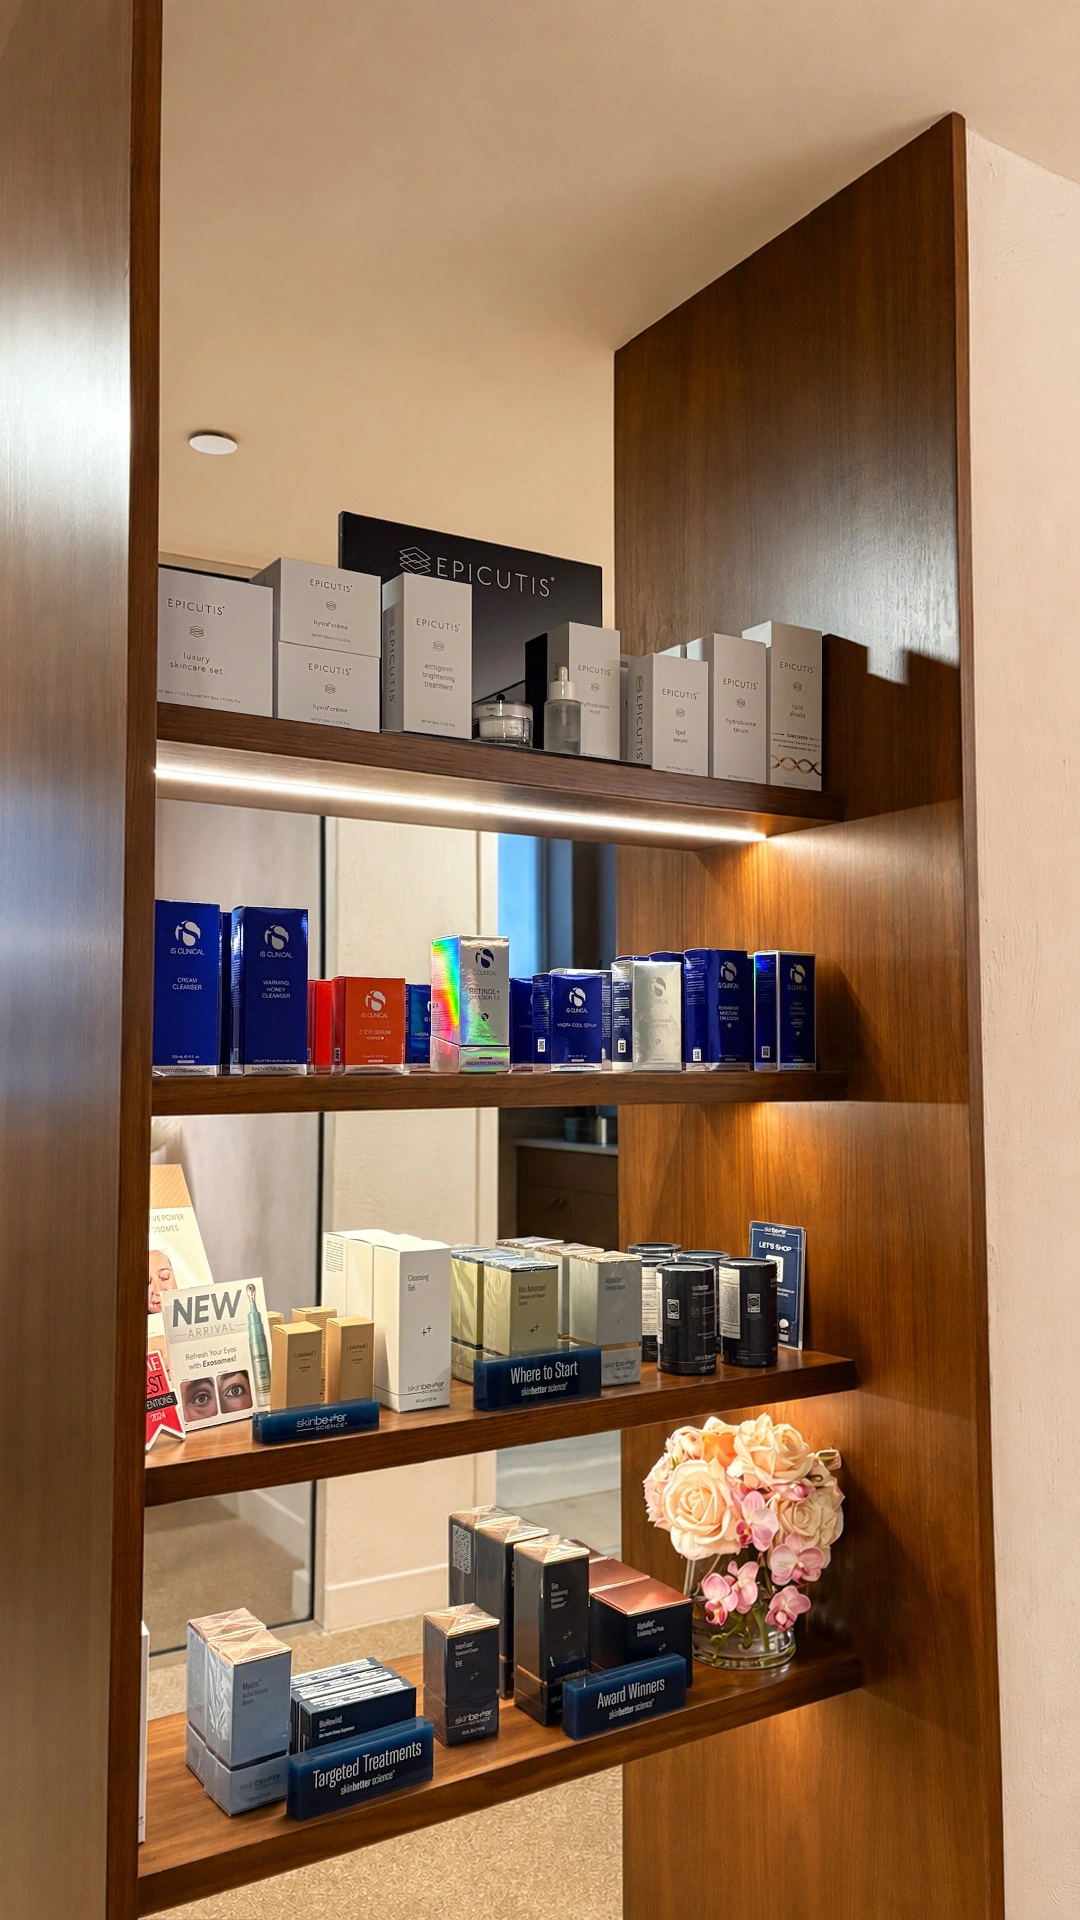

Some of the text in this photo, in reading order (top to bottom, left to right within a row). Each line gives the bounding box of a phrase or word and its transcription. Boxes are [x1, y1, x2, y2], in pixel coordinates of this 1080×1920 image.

[183, 652, 210, 664] luxury
[170, 661, 223, 675] skincare set
[421, 671, 455, 683] brightening
[424, 681, 453, 691] treatment
[725, 717, 757, 727] hydrobiome
[177, 947, 205, 956] CLINICAL
[266, 951, 294, 959] CLINICAL
[172, 983, 203, 991] CLEANSER
[161, 1213, 185, 1221] POWER
[758, 1241, 792, 1252] LET'S SHOP
[407, 1273, 430, 1282] Cleansing
[407, 1283, 416, 1292] Gel
[172, 1289, 242, 1328] NEW
[187, 1323, 235, 1339] ARRIVAL
[185, 1345, 237, 1361] Refresh Your Eyes
[188, 1355, 237, 1370] with Exosomes!
[510, 1361, 579, 1385] Where to Start
[521, 1384, 547, 1397] skinbetter
[150, 1412, 166, 1422] 2024
[597, 1678, 665, 1709] Award Winners
[608, 1705, 634, 1720] skinbetter
[313, 1742, 422, 1789] Targeted Treatments
[340, 1770, 395, 1796] skinbetter science
